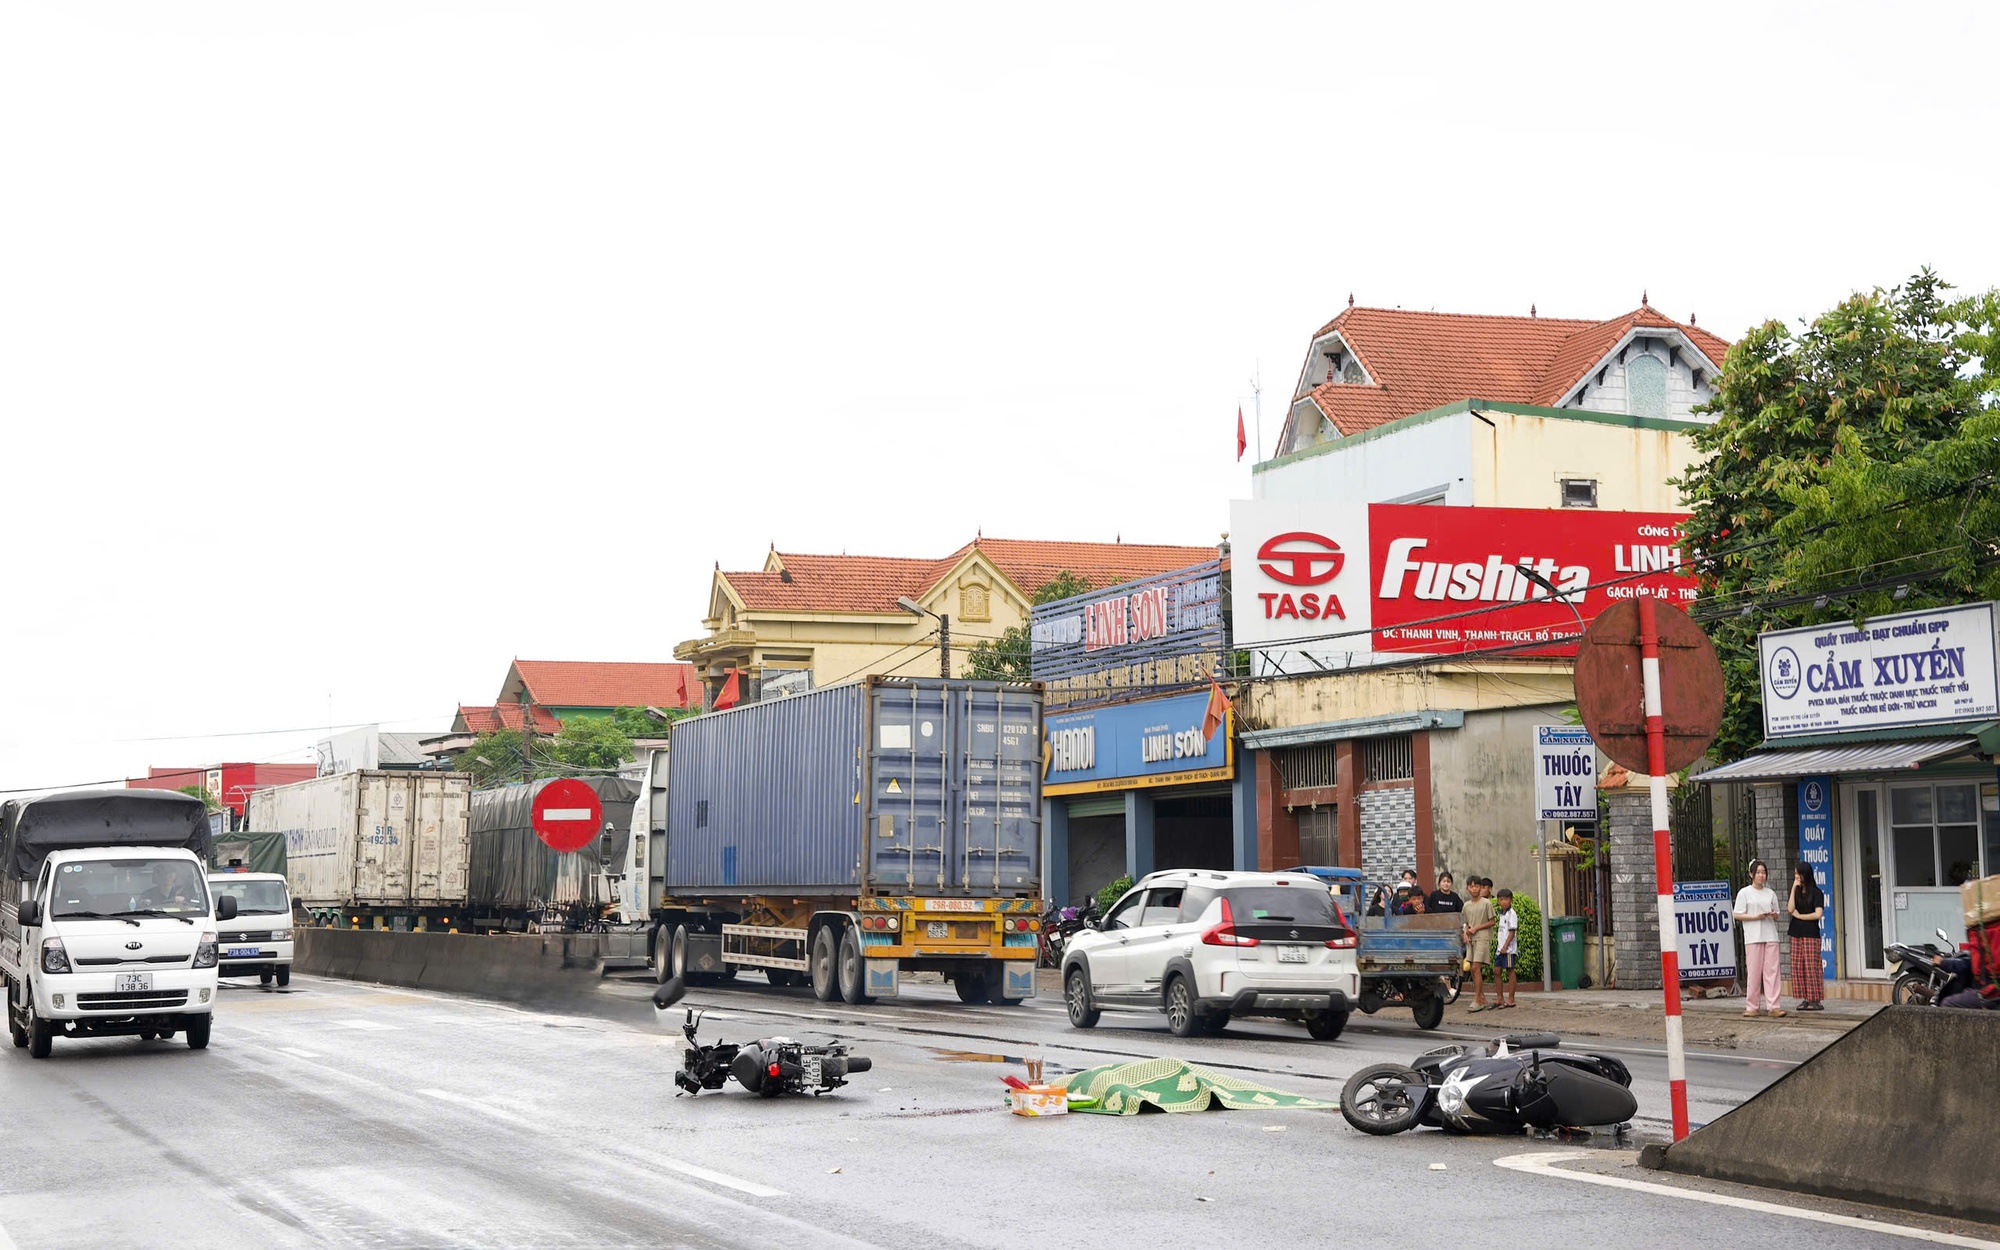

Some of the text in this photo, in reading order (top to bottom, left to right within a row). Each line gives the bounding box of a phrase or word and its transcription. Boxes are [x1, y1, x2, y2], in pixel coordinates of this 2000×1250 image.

[1637, 525, 1670, 537] CÔNG
[1379, 537, 1590, 603] Fushita
[1614, 544, 1681, 573] LINH
[1606, 586, 1634, 600] GẠCH
[1257, 593, 1347, 620] TASA
[1084, 596, 1129, 652] LINH
[1382, 628, 1398, 639] ĐC:
[1400, 629, 1433, 640] THANH
[1436, 630, 1461, 642] VINH,
[1464, 630, 1497, 641] THANH
[1535, 629, 1550, 641] BỐ
[1892, 619, 1926, 637] CHUẨN
[1928, 620, 1949, 633] GPP
[1807, 637, 1965, 693] CẨM XUYẾN
[1851, 690, 1868, 702] THUỐC
[1889, 689, 1904, 699] DANH
[1920, 683, 1938, 696] THUỐC
[1840, 704, 1858, 716] THUỐC
[1002, 736, 1019, 745] 45G1
[1142, 725, 1207, 763] LINH SƠN
[1543, 747, 1592, 776] THUỐC
[1554, 781, 1582, 807] TÂY
[1803, 845, 1829, 863] THUỐC
[1675, 903, 1729, 934] THUỐC
[1689, 939, 1719, 965] TÂY
[121, 983, 149, 991] 138.36
